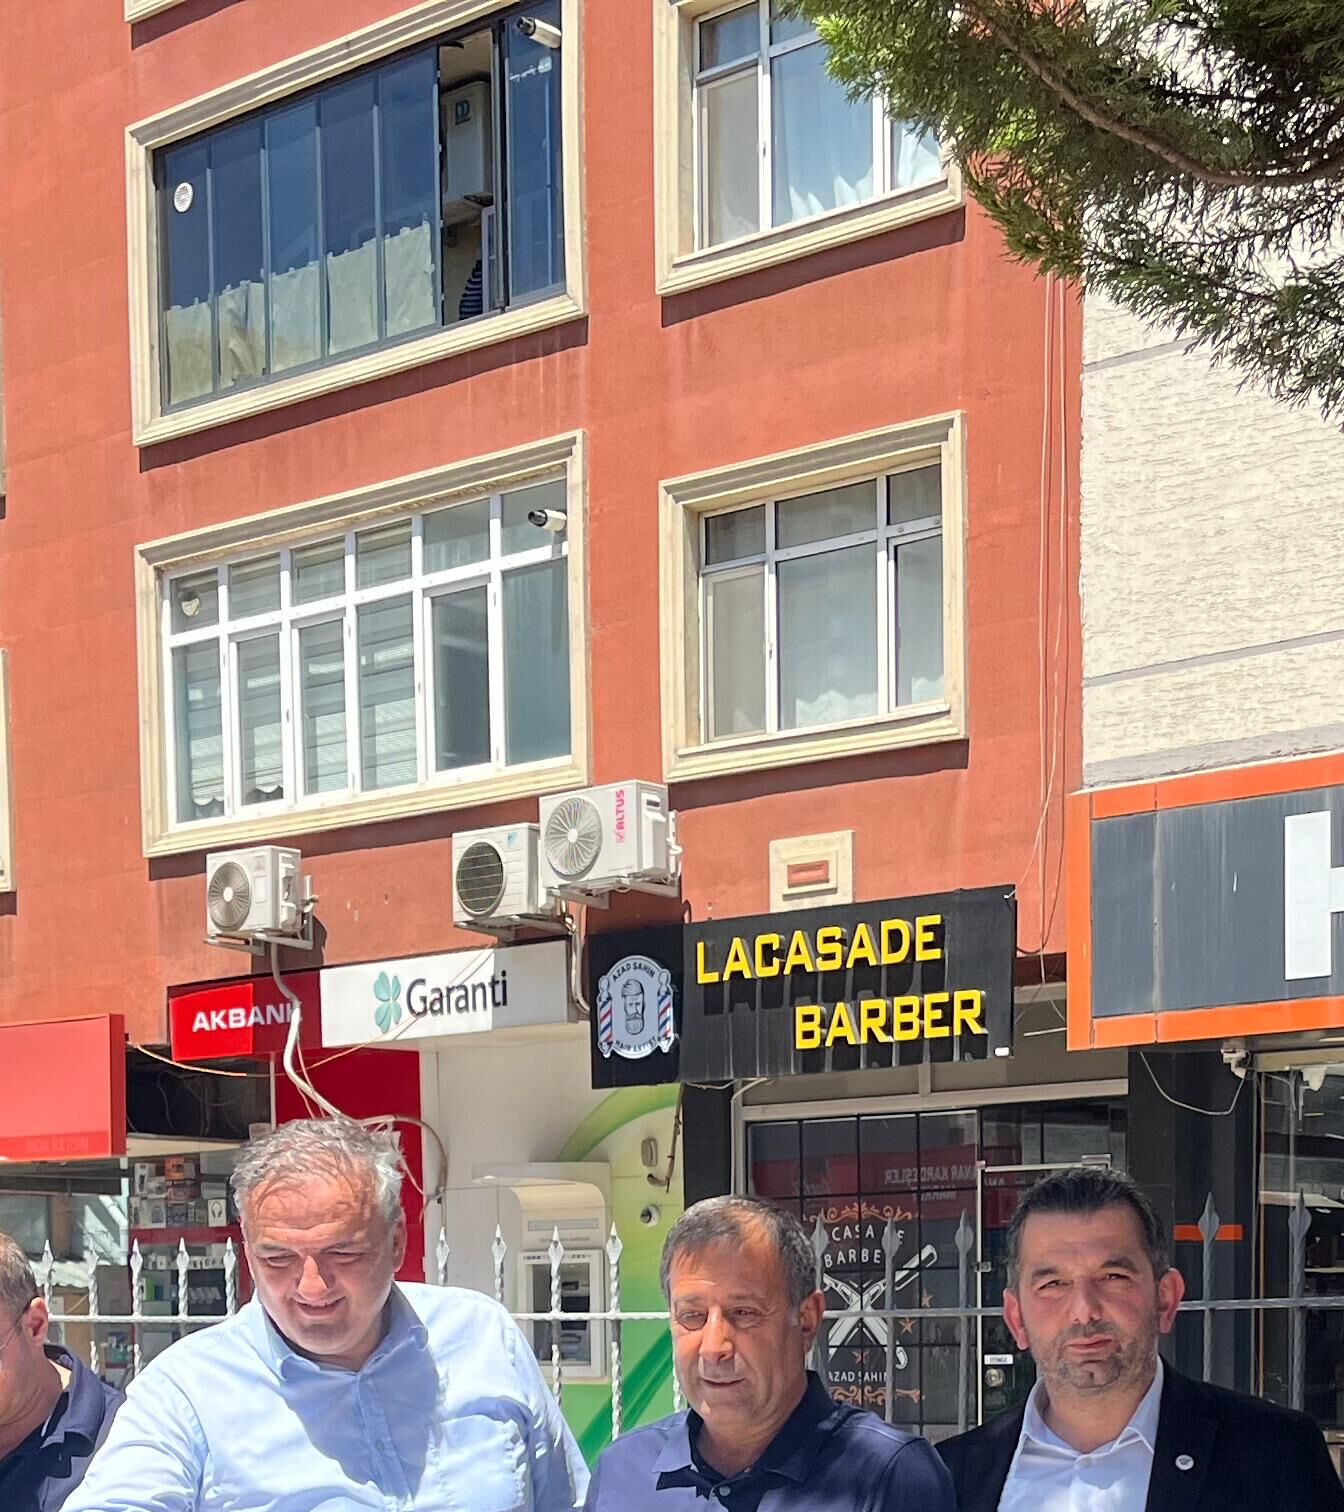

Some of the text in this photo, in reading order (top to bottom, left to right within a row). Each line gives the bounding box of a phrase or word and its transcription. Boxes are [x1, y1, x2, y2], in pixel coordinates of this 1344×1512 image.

[696, 914, 943, 985] LACASADE
[405, 970, 508, 1018] Garanti
[794, 988, 986, 1050] BARBER
[823, 1248, 882, 1268] BARBE
